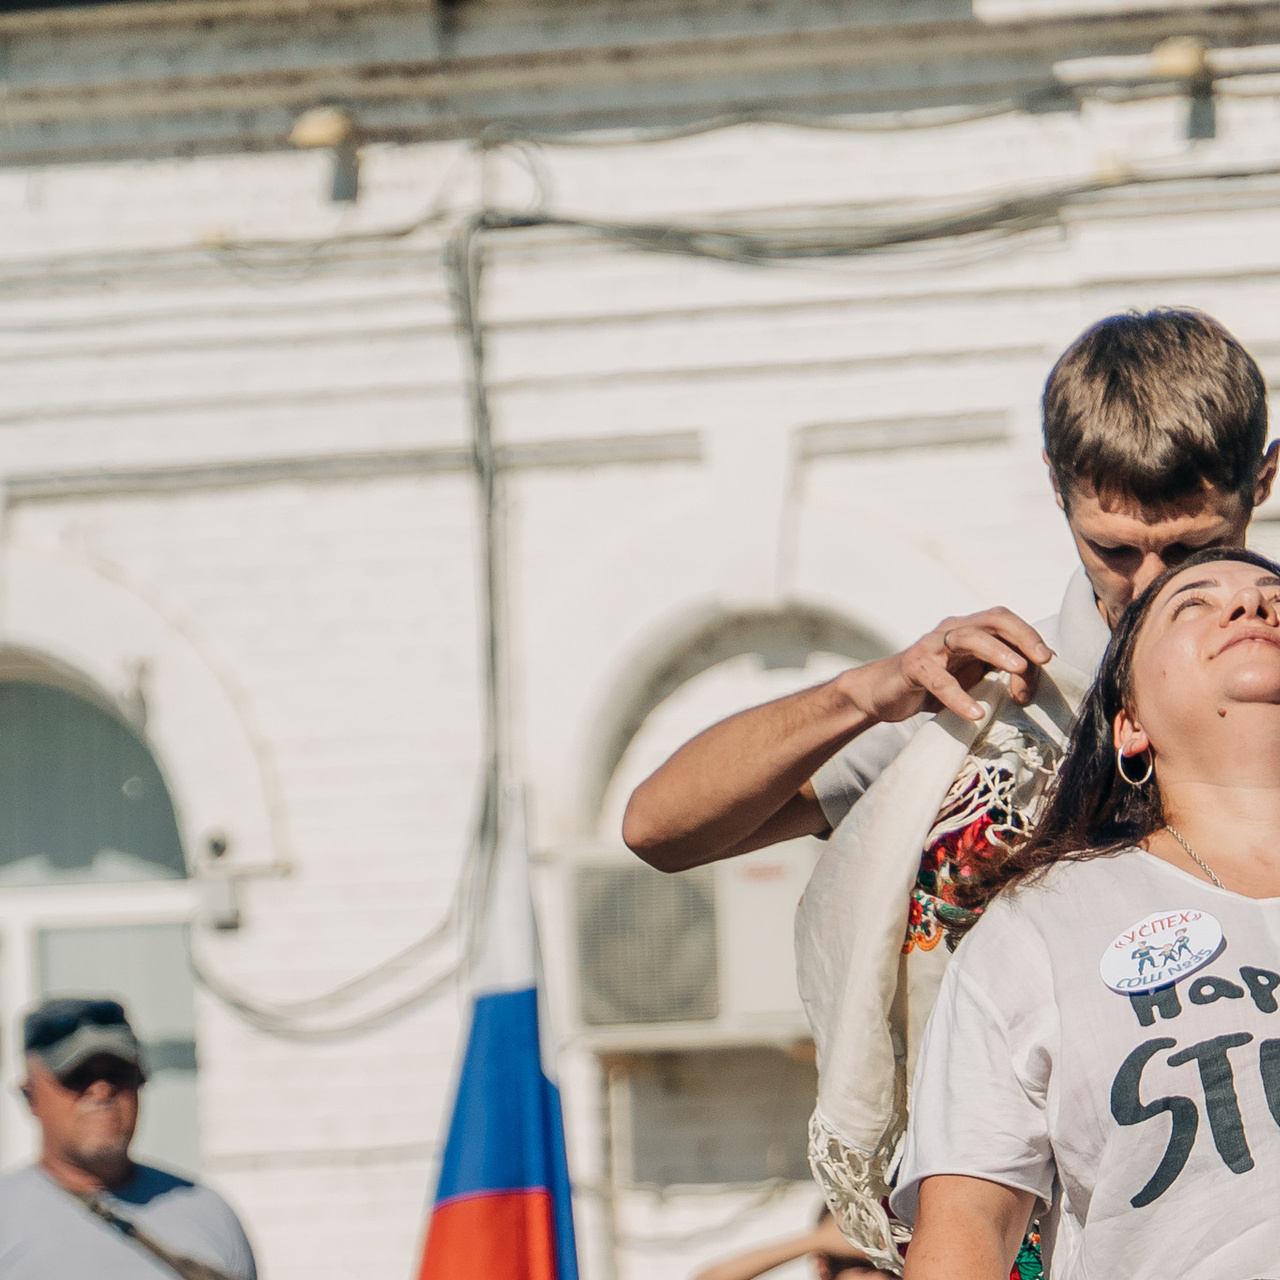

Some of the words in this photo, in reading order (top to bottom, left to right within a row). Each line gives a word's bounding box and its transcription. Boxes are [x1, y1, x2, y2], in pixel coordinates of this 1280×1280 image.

[1114, 911, 1202, 949] «УСПЕХ»
[1115, 971, 1163, 989] СОШ
[1167, 948, 1213, 976] №35
